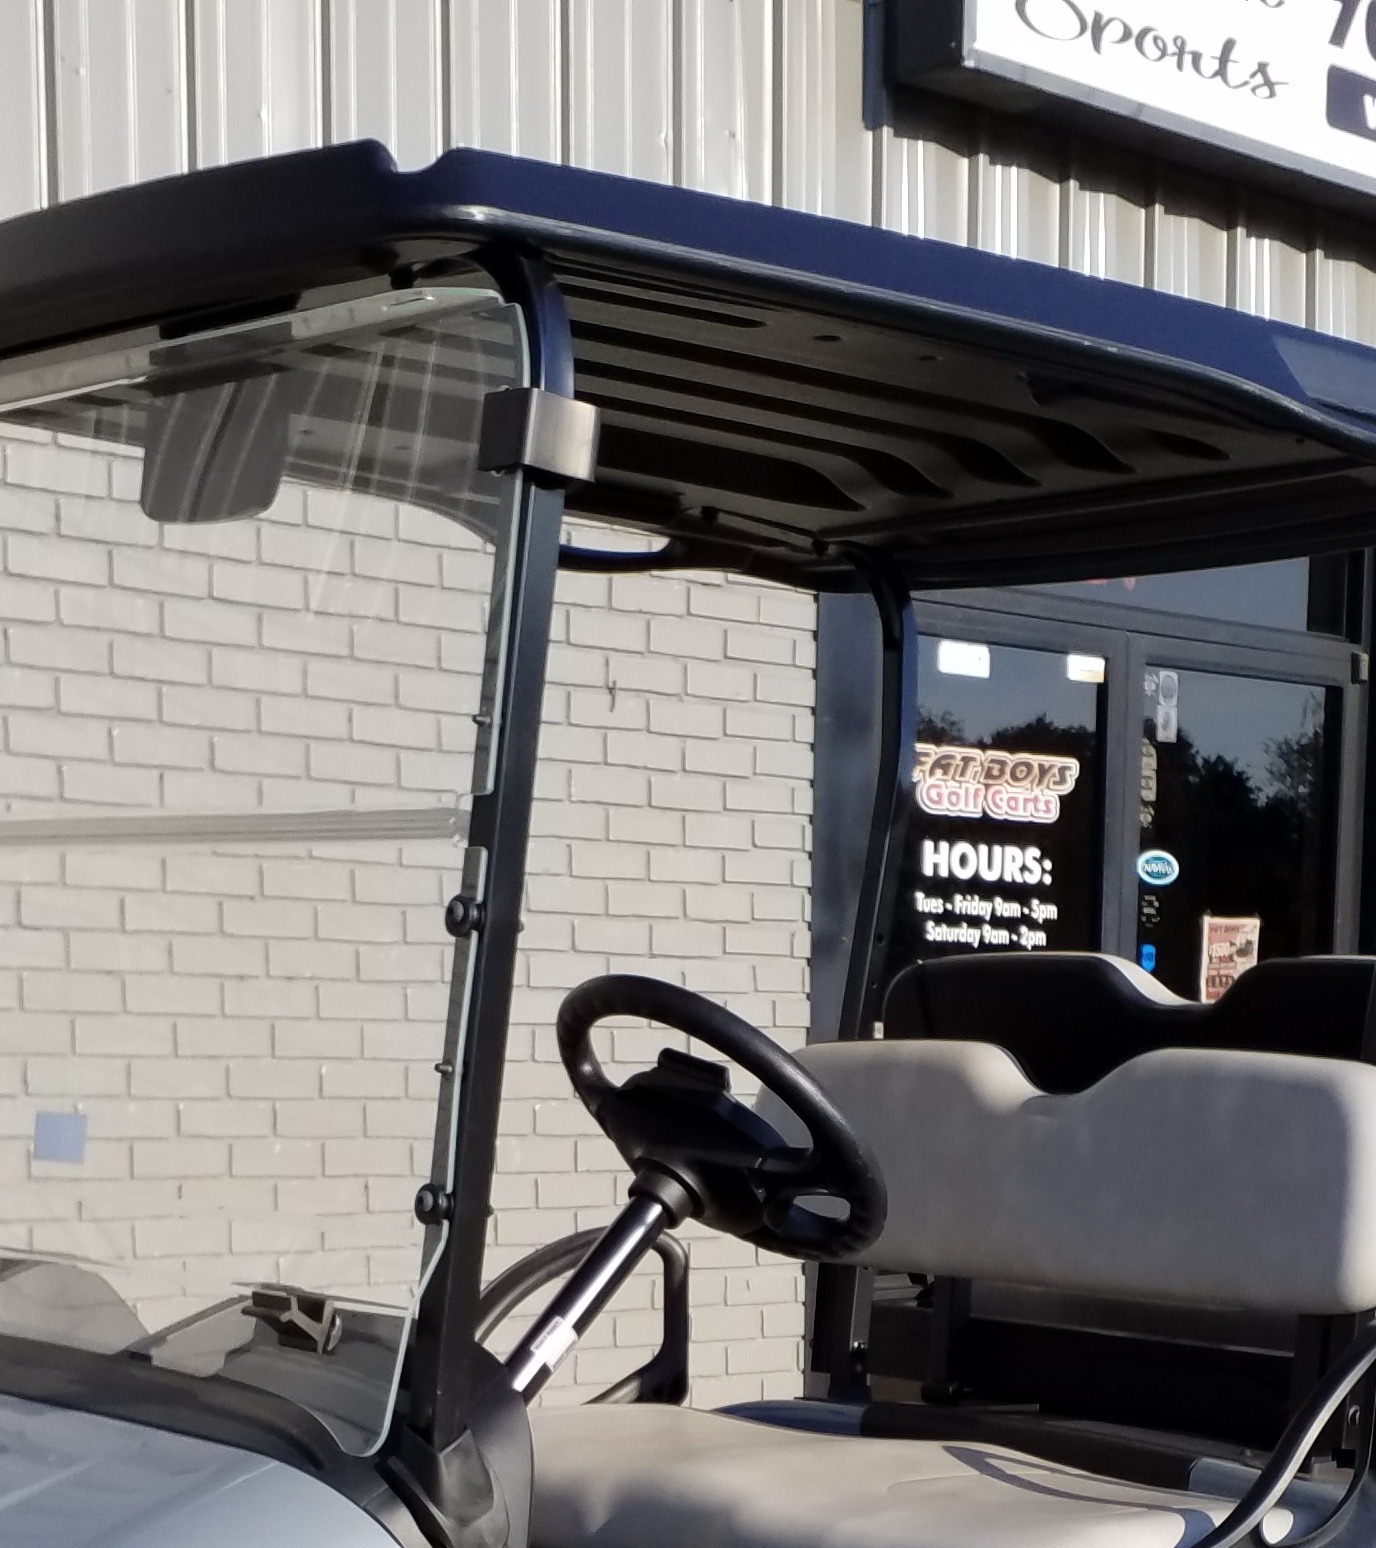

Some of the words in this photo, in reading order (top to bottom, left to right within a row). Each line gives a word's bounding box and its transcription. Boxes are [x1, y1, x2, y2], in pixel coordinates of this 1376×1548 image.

[982, 754, 1077, 791] BOYS
[925, 783, 985, 812] Golf
[989, 784, 1055, 817] Carts
[921, 838, 1053, 886] HOURS:
[915, 890, 944, 915] Tues
[954, 892, 993, 921] Friday
[994, 896, 1022, 919] 9am
[1031, 898, 1058, 925] 5pm
[926, 920, 981, 948] Saturday
[983, 924, 1010, 946] 9am
[1019, 925, 1047, 950] 2pm
